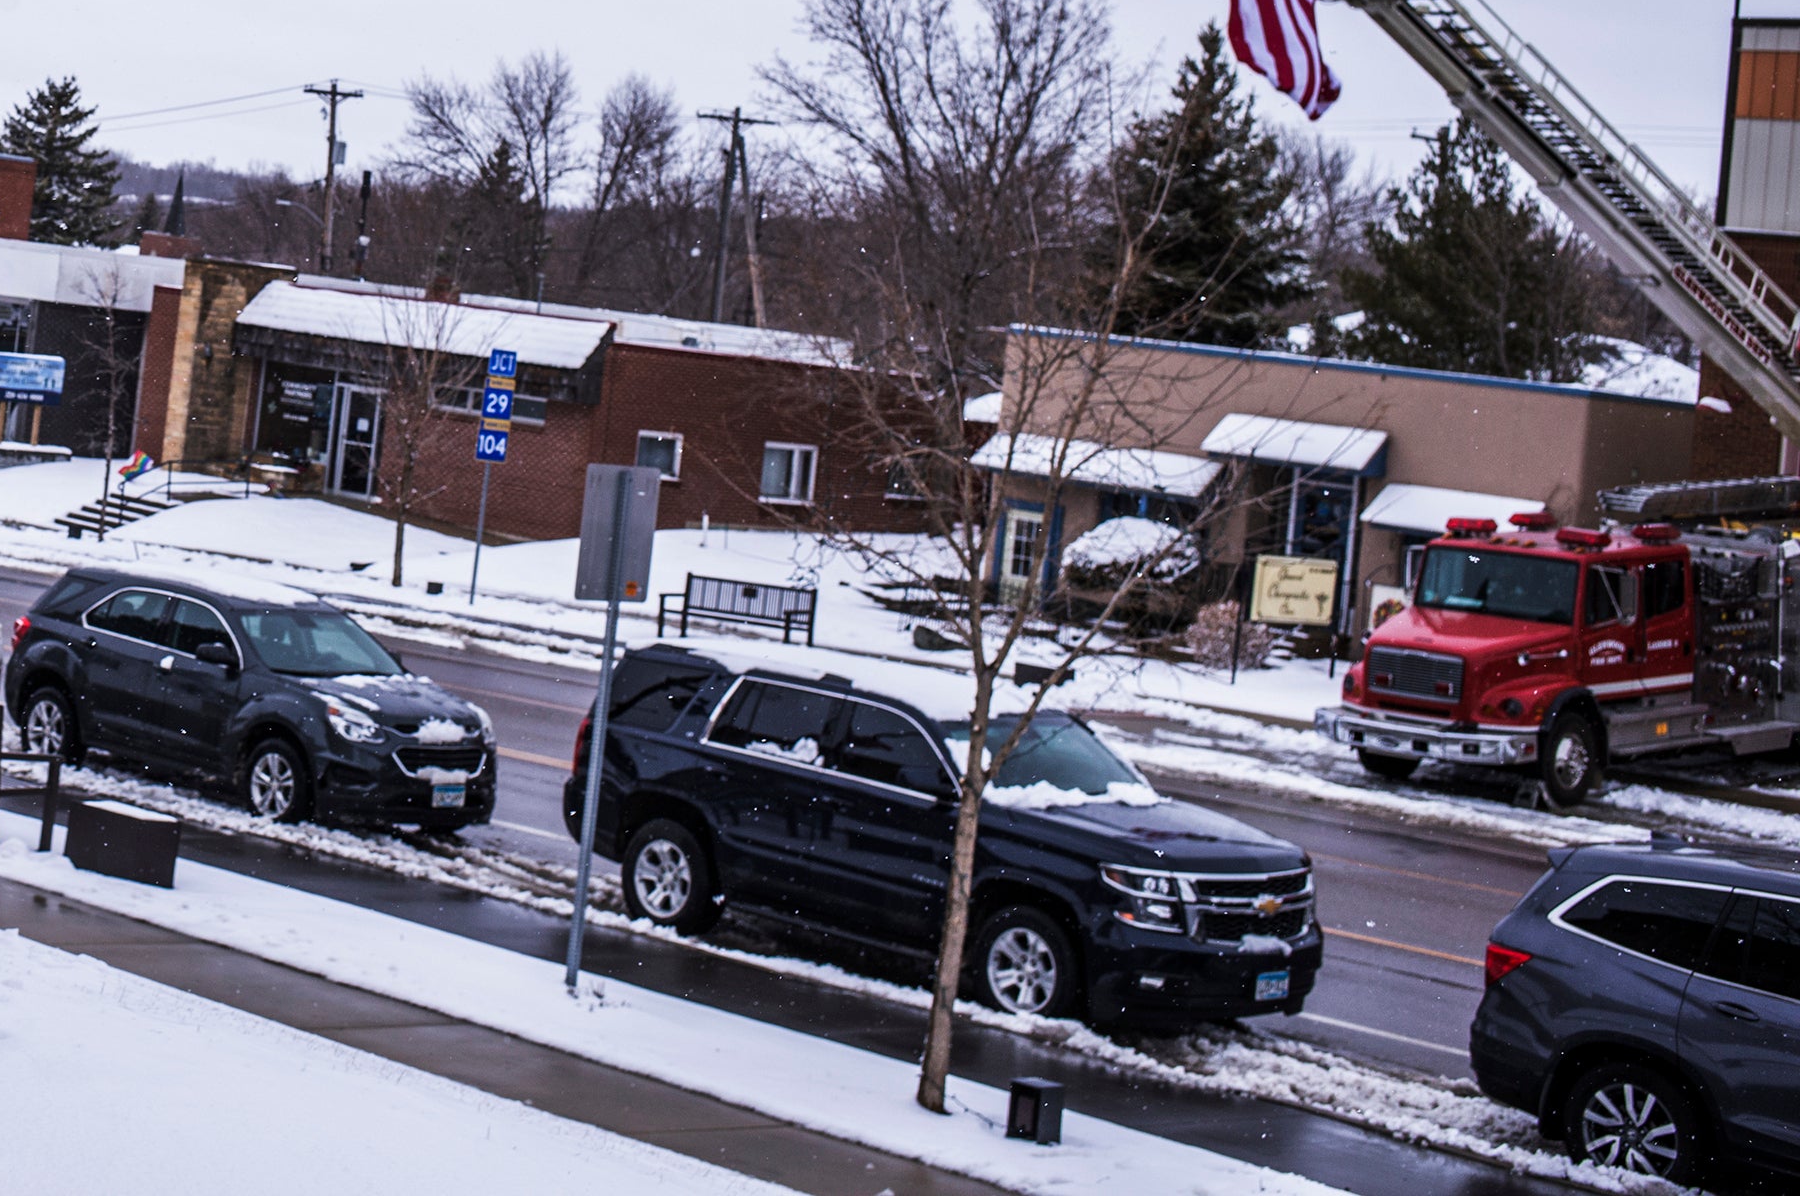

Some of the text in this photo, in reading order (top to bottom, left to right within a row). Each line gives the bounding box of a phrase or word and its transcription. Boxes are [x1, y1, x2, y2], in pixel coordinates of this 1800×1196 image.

[491, 353, 515, 372] JCT
[486, 392, 509, 414] 29
[478, 434, 506, 456] 104
